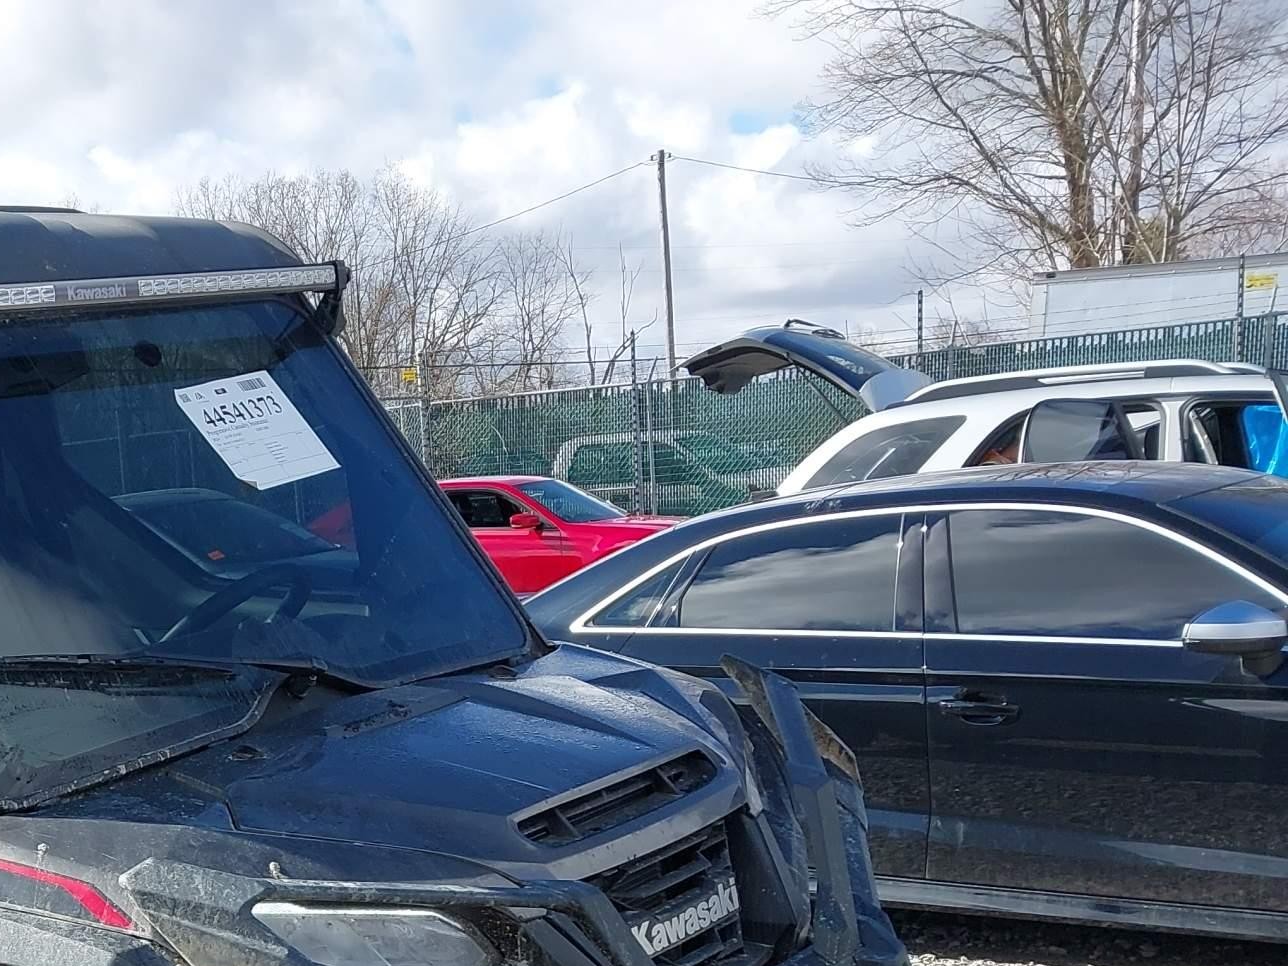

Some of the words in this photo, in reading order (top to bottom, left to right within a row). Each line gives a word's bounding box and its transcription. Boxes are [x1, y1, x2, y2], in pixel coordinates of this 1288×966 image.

[66, 282, 127, 301] Kawasaki
[202, 395, 283, 427] 44541373
[630, 877, 740, 956] Kawasaki
